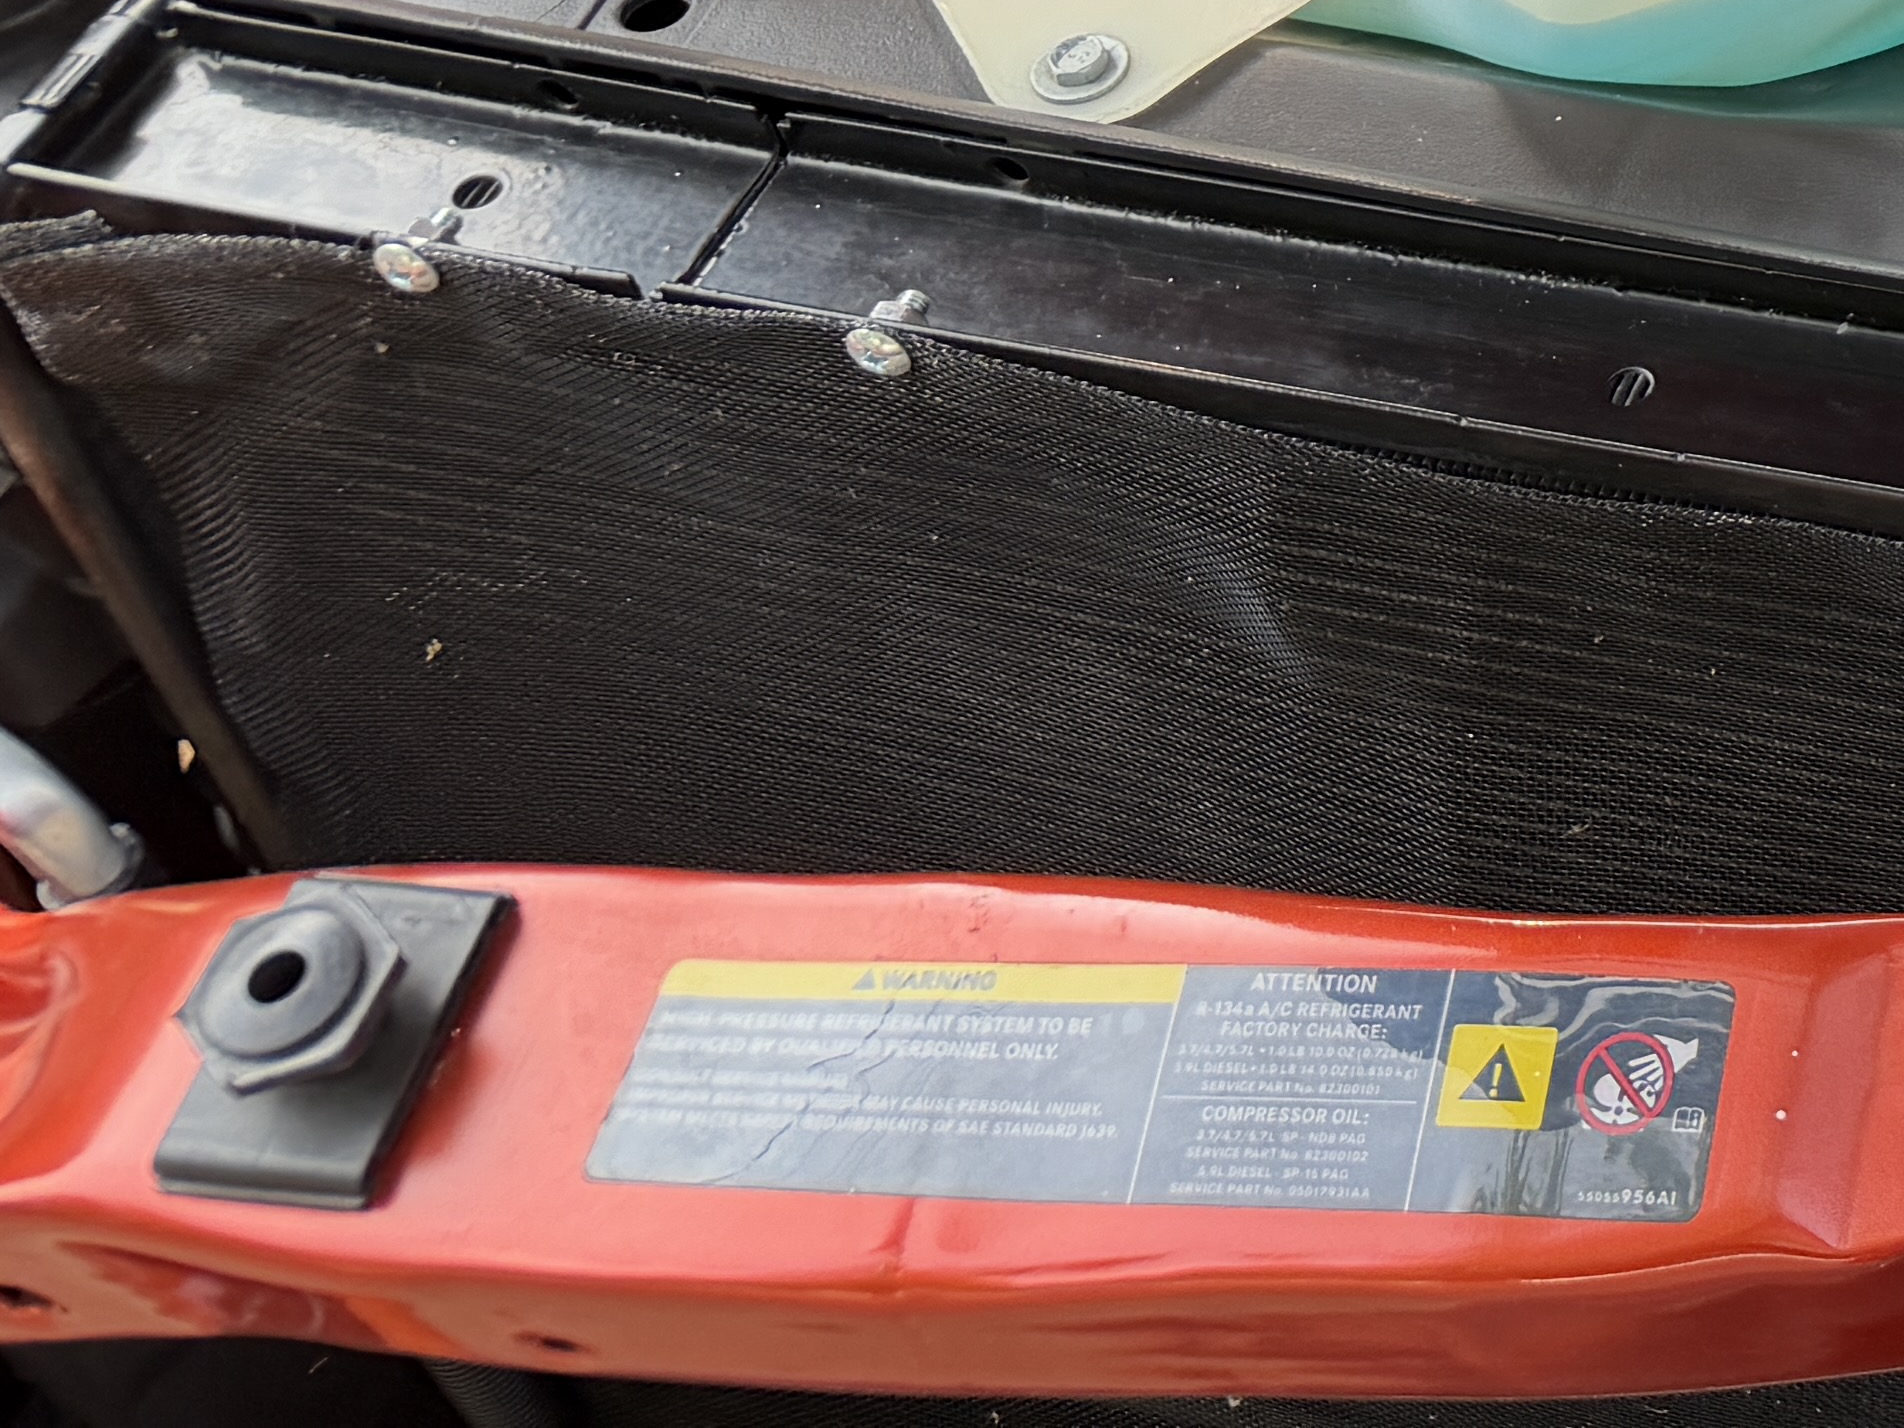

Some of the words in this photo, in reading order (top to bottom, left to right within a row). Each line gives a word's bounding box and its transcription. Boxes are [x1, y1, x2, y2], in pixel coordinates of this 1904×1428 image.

[879, 969, 997, 991] WARNING
[1251, 972, 1377, 994] ATTENTION
[1195, 1001, 1255, 1017] R-134a
[1257, 1002, 1293, 1019] A/C
[1298, 1003, 1423, 1021] REFRIGERANT
[720, 1012, 815, 1032] PRESSURE
[822, 1014, 954, 1035] REFRIGERANT
[958, 1015, 1033, 1036] SYSTEM
[1037, 1016, 1064, 1036] TO
[1068, 1016, 1094, 1037] BE
[1220, 1021, 1301, 1037] FACTORY
[1306, 1023, 1389, 1040] CHARGE:
[883, 1039, 1000, 1060] PERSONNEL
[1005, 1042, 1059, 1061] ONLY.
[1202, 1063, 1250, 1075] DIESEL
[1200, 1080, 1256, 1093] SERVICE
[1258, 1081, 1291, 1093] PART
[864, 1096, 899, 1113] MAY
[902, 1097, 953, 1114] CAUSE
[958, 1099, 1042, 1116] PERSONAL
[1045, 1101, 1103, 1118] INJURY.
[1201, 1105, 1327, 1123] COMPRESSOR
[1331, 1108, 1370, 1125] OIL:
[958, 1120, 988, 1135] SAE
[992, 1121, 1077, 1138] STANDARD
[1185, 1147, 1242, 1159] SERVICE
[1243, 1148, 1277, 1160] PART
[1169, 1181, 1226, 1194] SERVICE
[1227, 1183, 1261, 1195] PART
